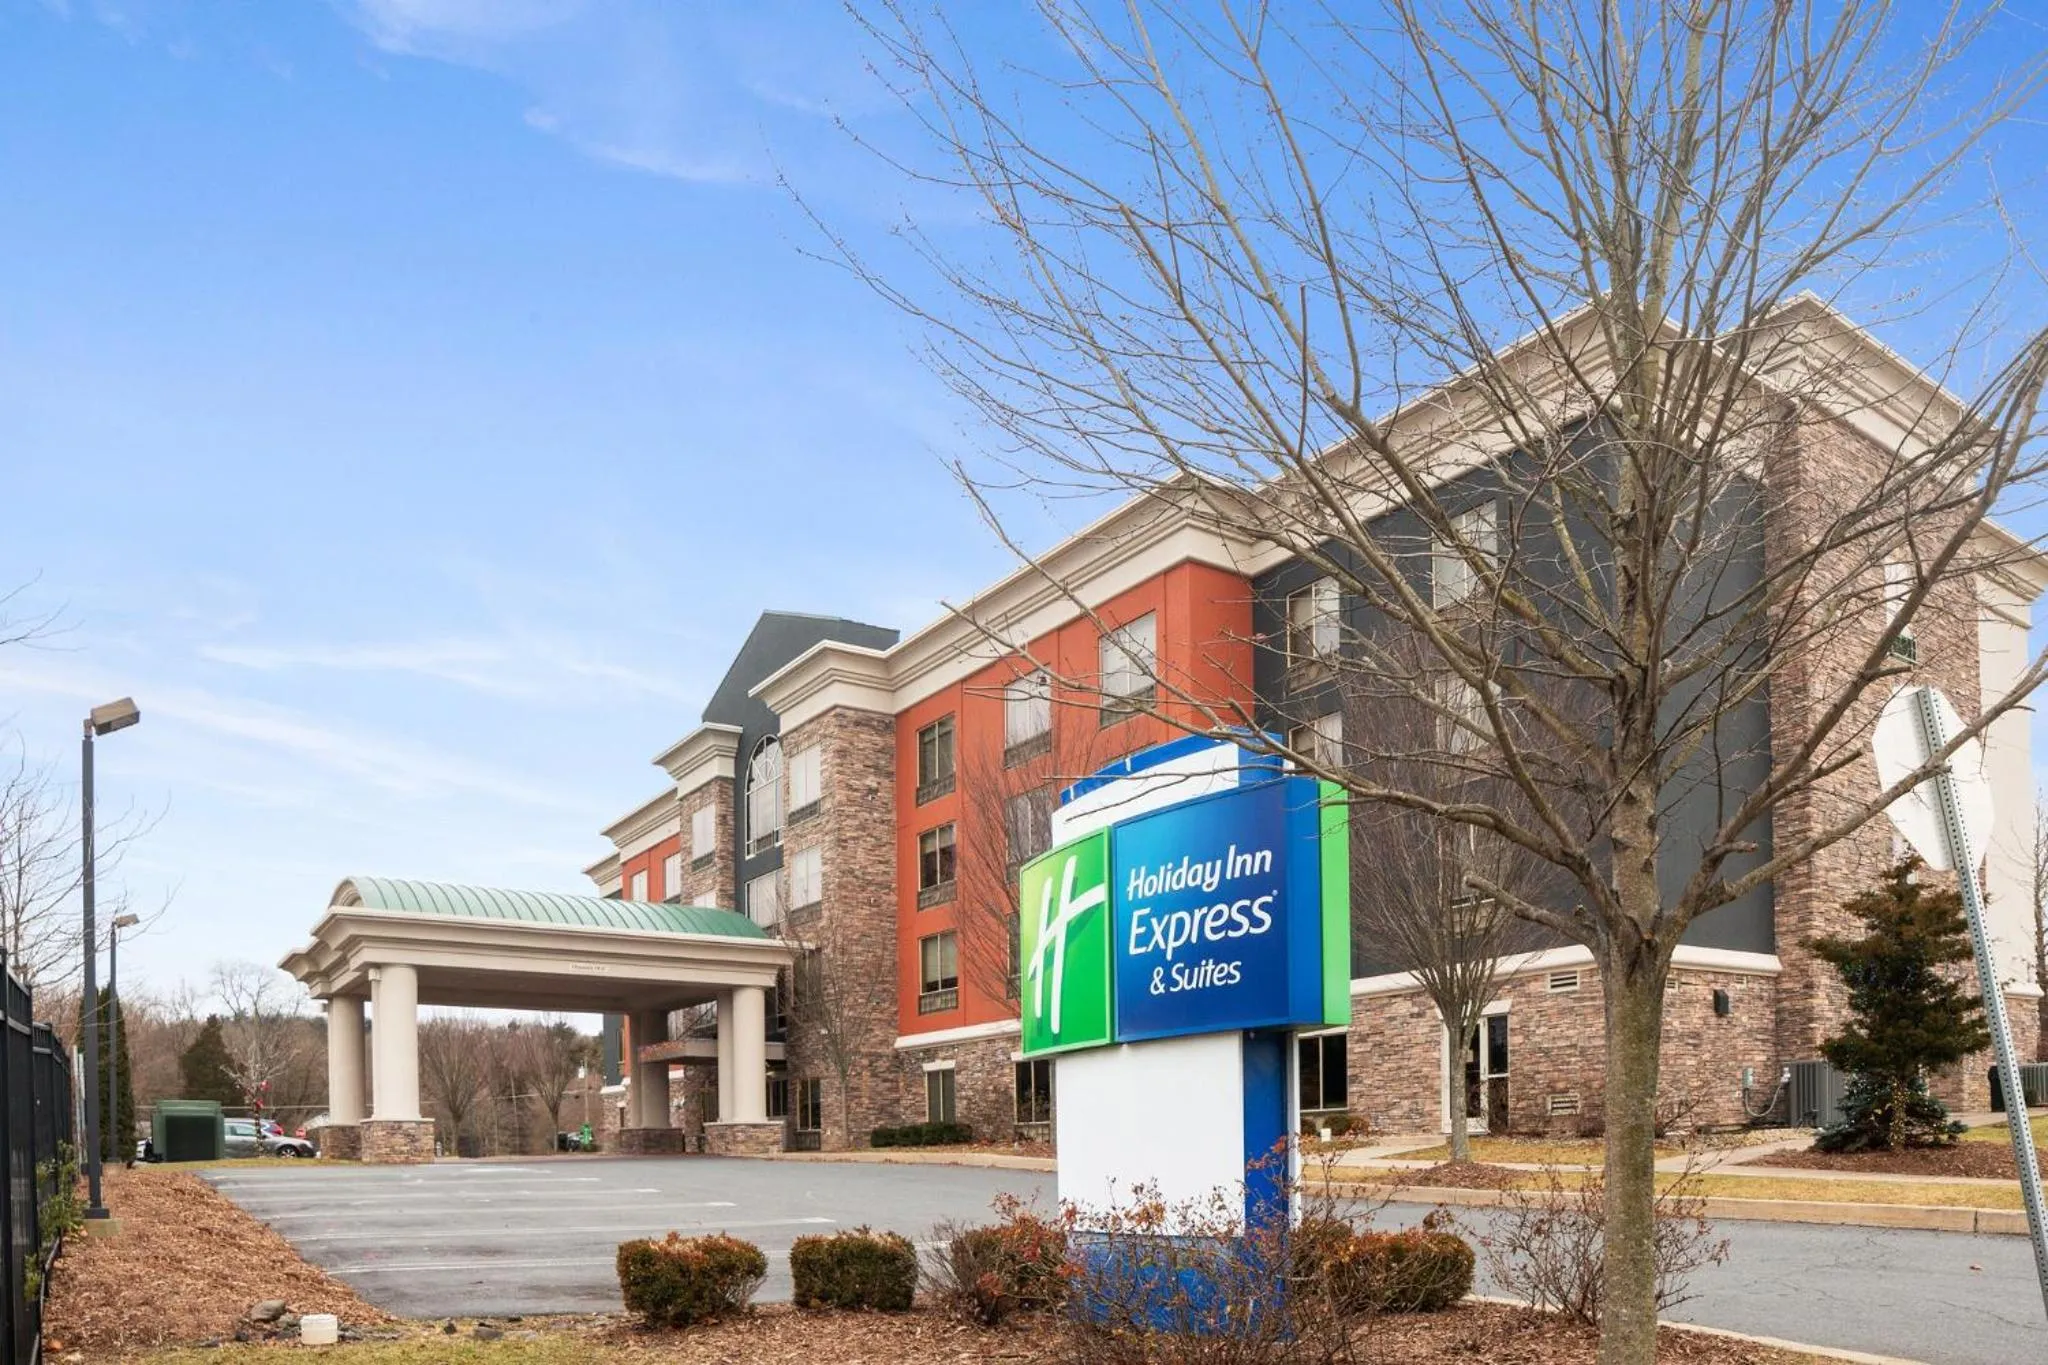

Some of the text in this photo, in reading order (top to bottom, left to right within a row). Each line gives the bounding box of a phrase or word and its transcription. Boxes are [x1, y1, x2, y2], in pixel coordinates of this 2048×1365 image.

[1126, 844, 1272, 901] Holiday Inn
[1129, 896, 1274, 961] Express
[1150, 959, 1242, 995] & Suites
